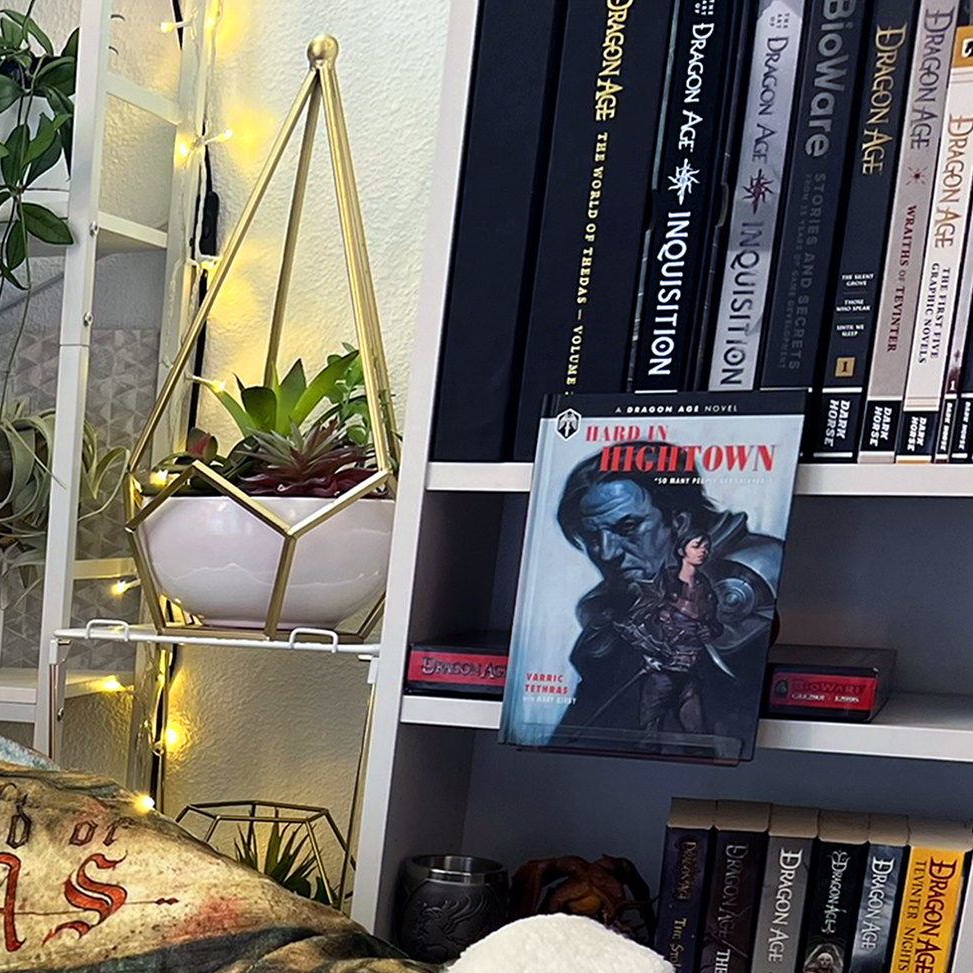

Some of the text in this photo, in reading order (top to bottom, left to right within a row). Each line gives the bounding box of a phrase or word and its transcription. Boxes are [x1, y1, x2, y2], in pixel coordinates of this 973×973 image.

[595, 78, 624, 121] AGE
[679, 22, 715, 153] DRAGON AGE
[752, 36, 789, 164] DRAGON AGE
[805, 0, 855, 158] BioWare
[861, 22, 907, 176] DRAGON AGE
[910, 6, 955, 150] DRAGON AGE
[595, 132, 608, 162] THE
[587, 166, 604, 219] WORLD
[935, 113, 973, 248] DRAGON AGE
[585, 223, 597, 242] OF
[900, 204, 917, 266] WRAITHS
[577, 247, 593, 304] THEDAS
[647, 211, 691, 376] INQUISITION
[788, 172, 826, 370] STORIES AND SECRETS
[720, 222, 764, 385] INQUISITION
[887, 286, 905, 352] TEVINTER
[919, 262, 939, 364] GRAPHIC NOVELS
[930, 268, 951, 358] THE FIRST FIVE
[566, 325, 583, 386] VOLUME
[585, 425, 669, 442] HARD IN
[627, 406, 673, 414] DRAGON
[678, 405, 699, 413] AGE
[705, 404, 737, 412] NOVEL
[824, 399, 839, 447] HORSE
[836, 398, 851, 439] DARK
[869, 406, 883, 447] HORSE
[880, 406, 893, 440] DARK
[907, 416, 919, 452] HORSE
[916, 416, 927, 446] DARK
[599, 444, 777, 473] HIGHTOWN
[669, 477, 689, 485] MANY
[422, 656, 481, 677] DRAGON
[525, 684, 568, 694] TETHRAS
[527, 672, 563, 683] VARRIC
[717, 842, 748, 938] DRAGON AGE
[768, 848, 803, 962] DRAGON AGE
[821, 851, 849, 934] DRAGON AGE
[861, 856, 895, 950] DRAGON AGE
[898, 860, 926, 972] TEVINTER NIGHTS
[923, 856, 958, 938] DRAGON
